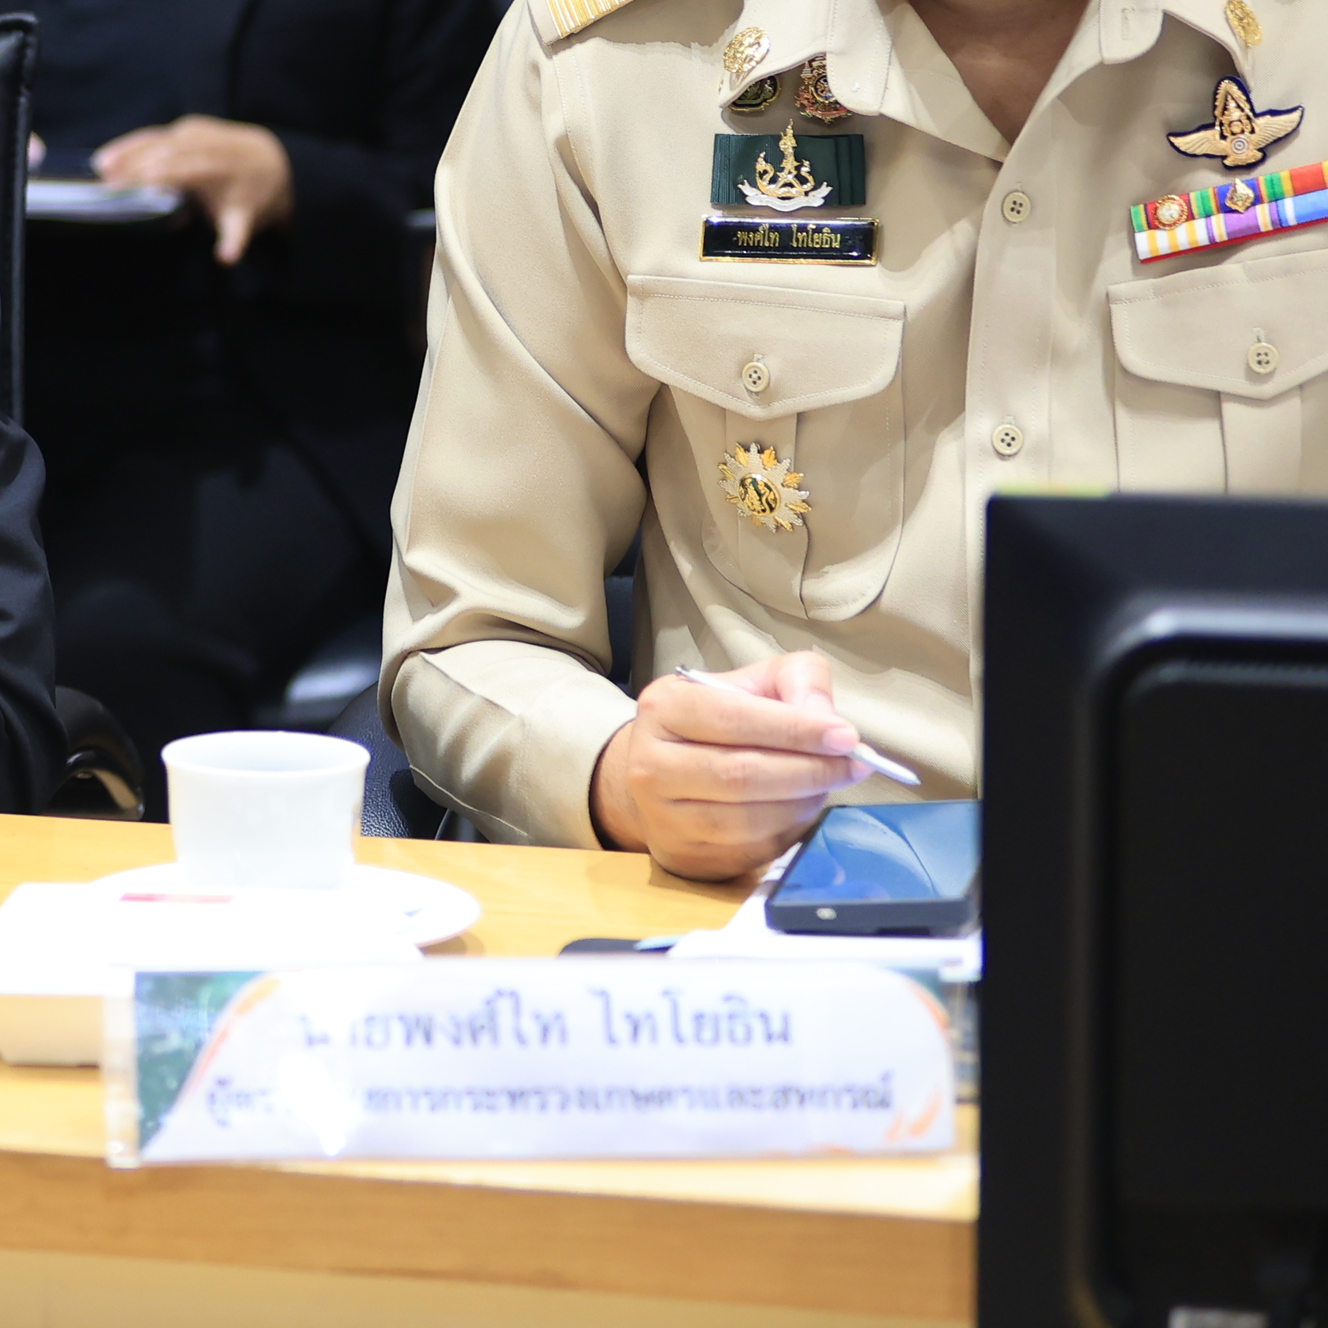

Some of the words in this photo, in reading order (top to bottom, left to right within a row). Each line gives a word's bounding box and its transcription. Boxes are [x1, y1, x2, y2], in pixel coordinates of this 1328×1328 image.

[791, 224, 841, 249] ไทโยธิน
[589, 987, 793, 1048] ไทโยธิน
